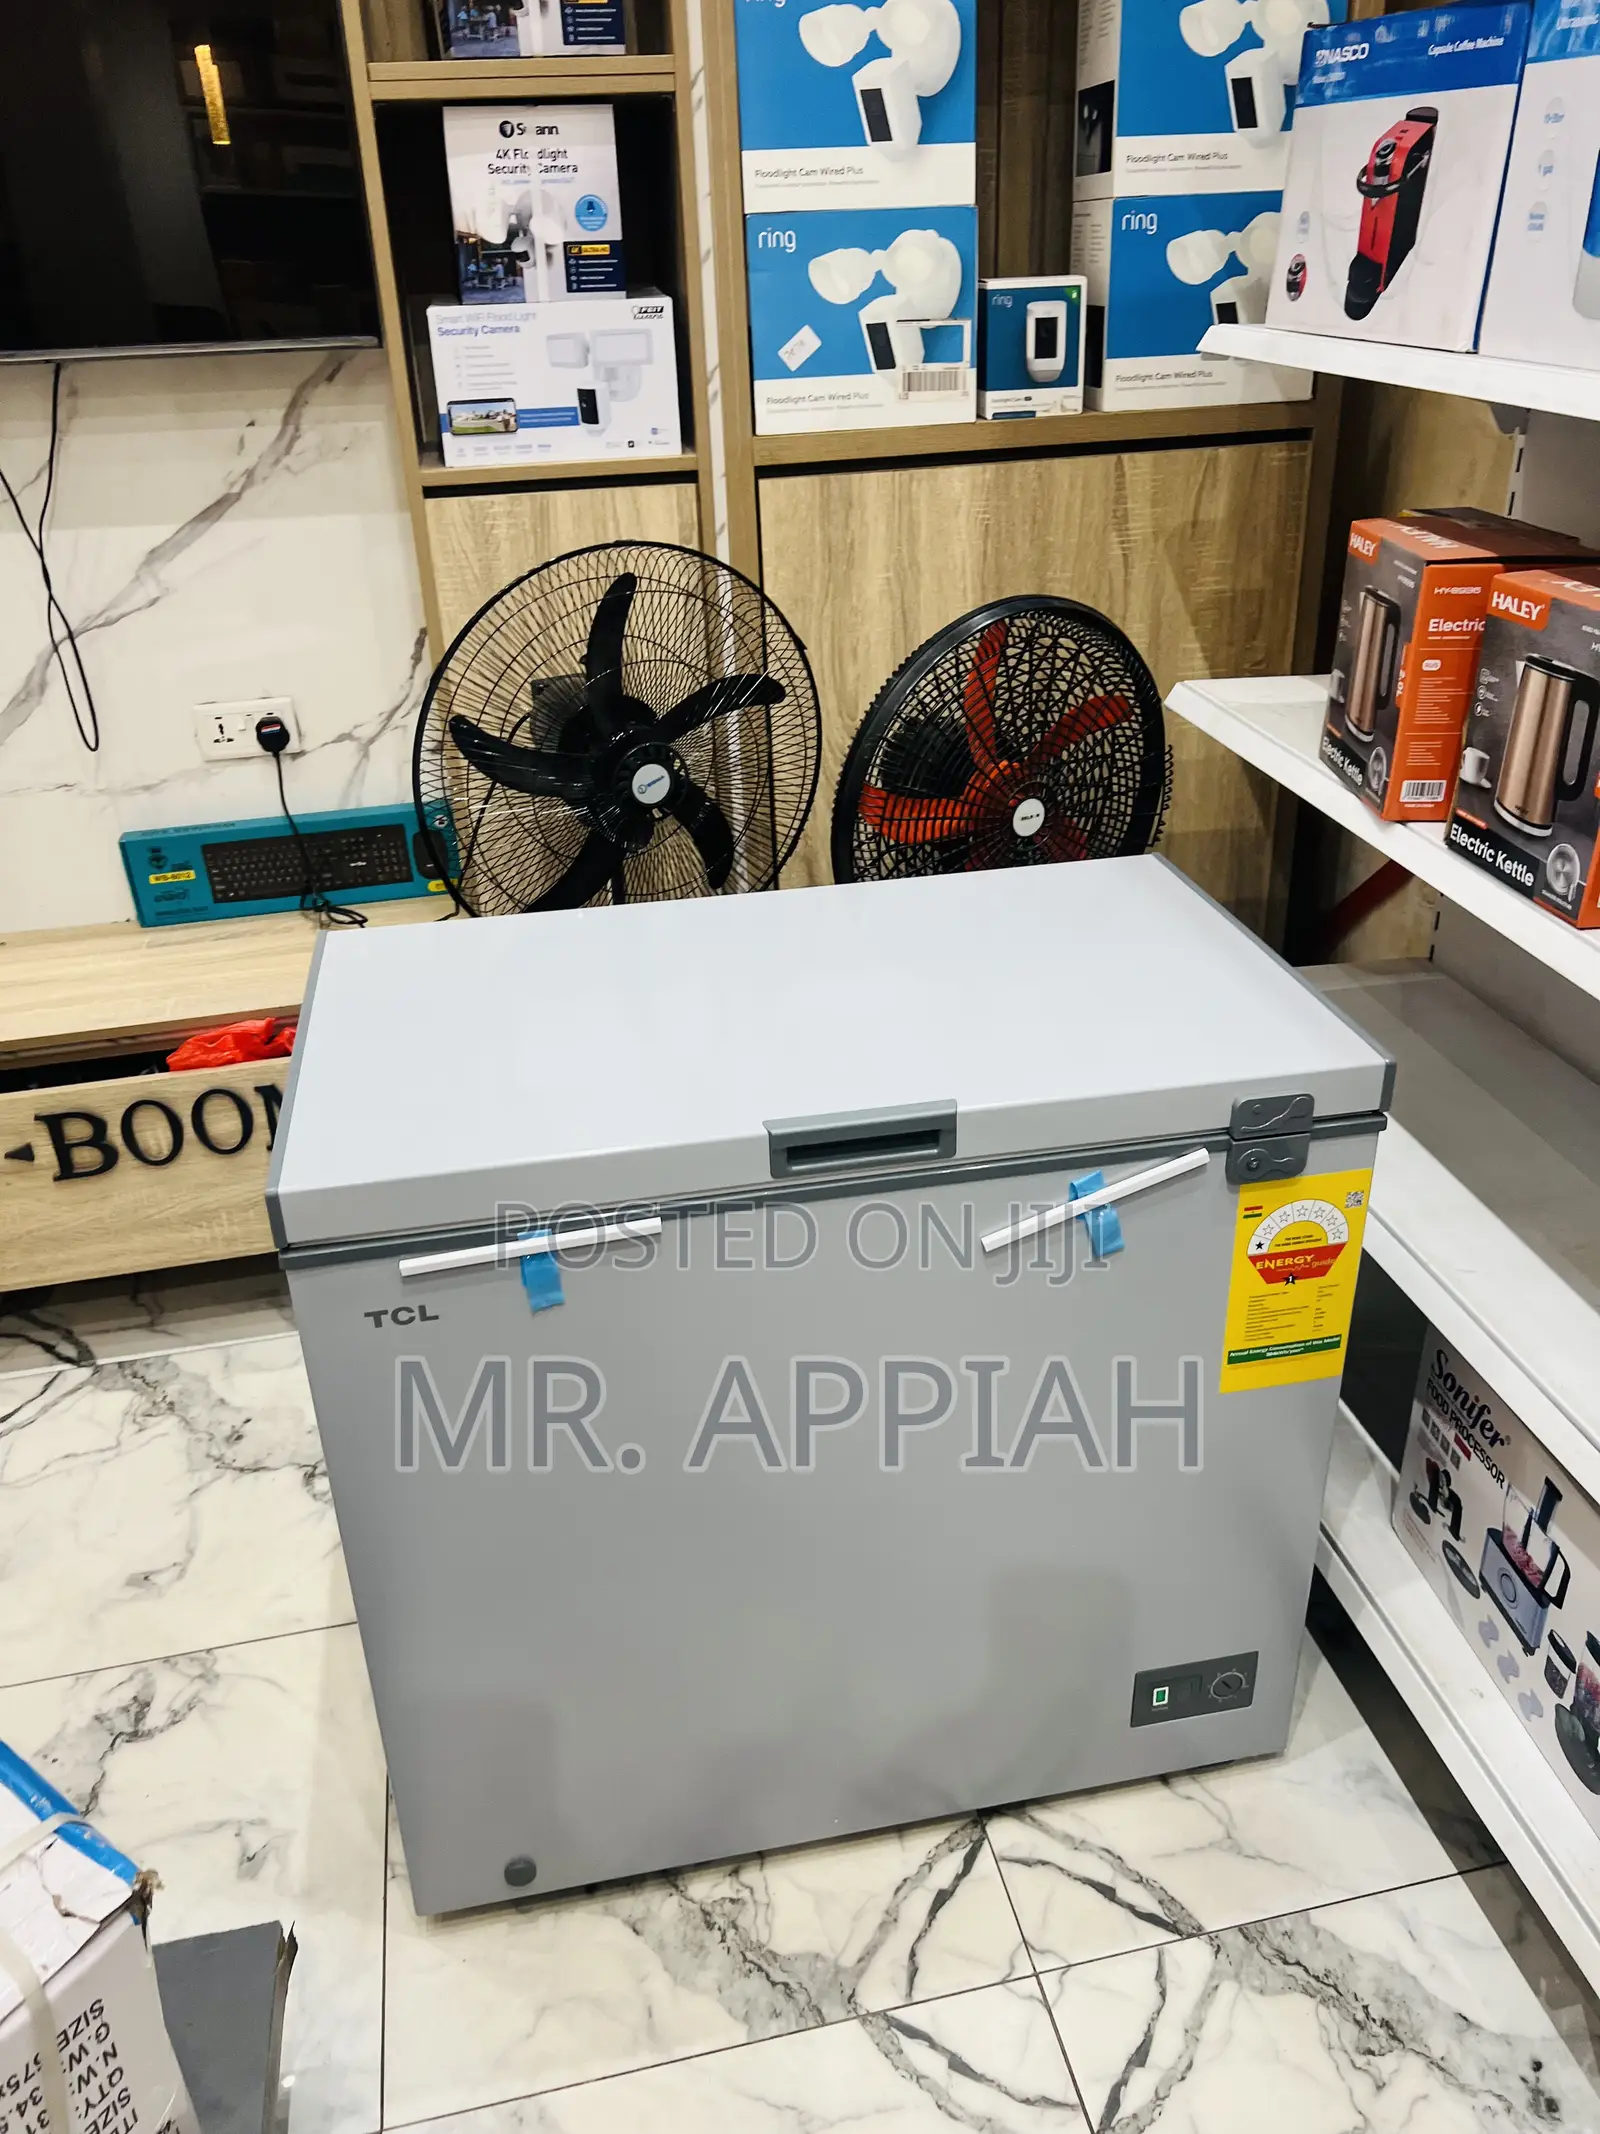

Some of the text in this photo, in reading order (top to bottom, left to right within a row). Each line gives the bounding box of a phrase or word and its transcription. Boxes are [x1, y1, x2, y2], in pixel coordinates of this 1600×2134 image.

[755, 166, 864, 179] Floodlight Cam Wired Plus
[1121, 210, 1158, 235] ring
[758, 227, 796, 253] ring
[990, 294, 1013, 308] ring
[437, 324, 520, 337] Security Camera
[1349, 532, 1377, 557] HALEY
[1491, 591, 1541, 621] HALEY
[1428, 618, 1486, 632] Electric
[1449, 823, 1535, 887] Electric Kettle
[1255, 1254, 1315, 1270] ENERGY
[363, 1304, 440, 1329] TCL
[1430, 1348, 1506, 1449] Sonifer
[1427, 1377, 1506, 1491] FOOD PROCESSOR
[56, 1998, 104, 2052] SIZE
[61, 2021, 110, 2073] G.W:
[69, 2042, 117, 2095] N.W:
[74, 2067, 123, 2118] QTY:
